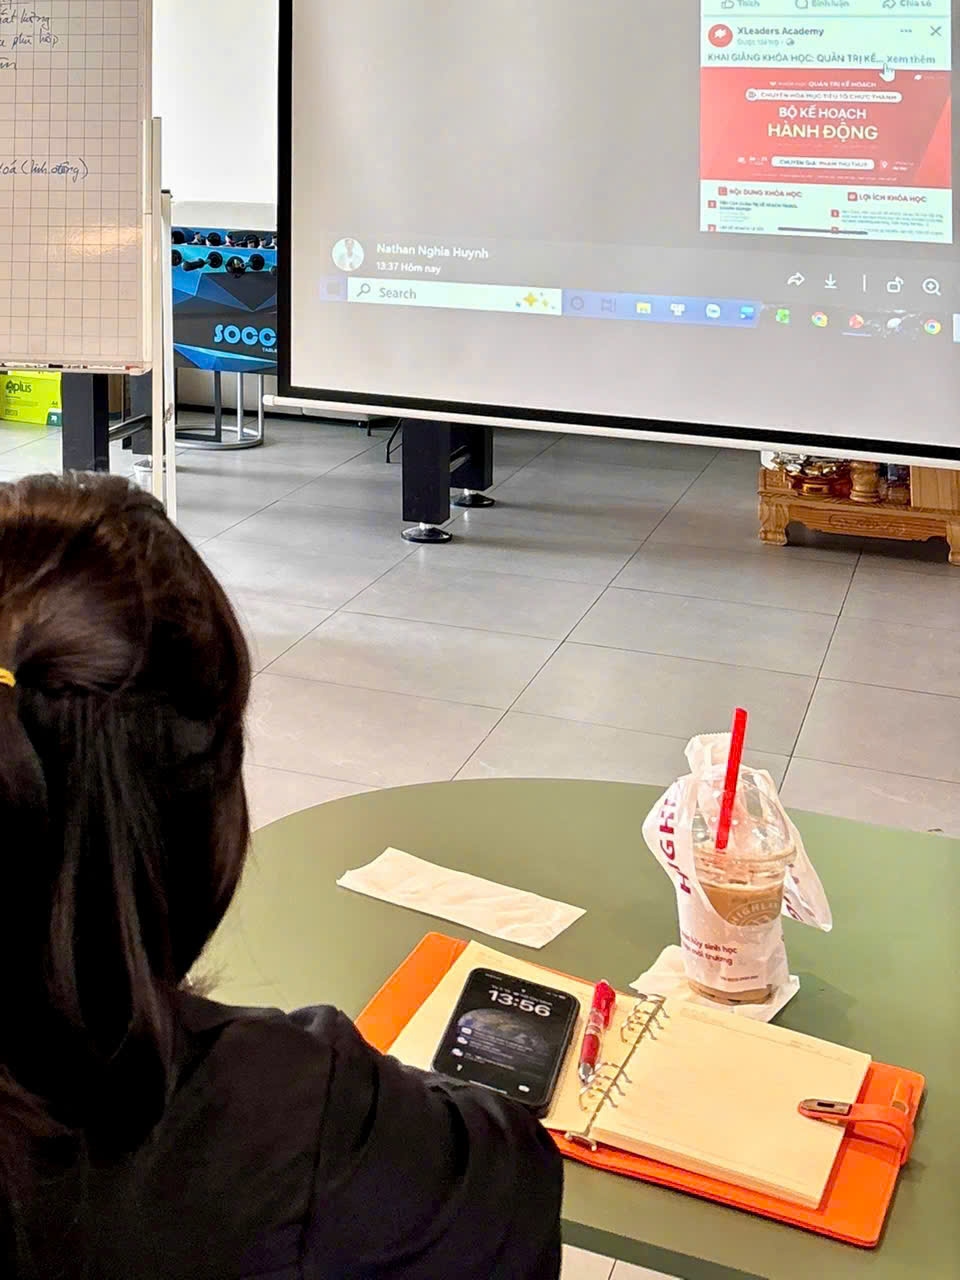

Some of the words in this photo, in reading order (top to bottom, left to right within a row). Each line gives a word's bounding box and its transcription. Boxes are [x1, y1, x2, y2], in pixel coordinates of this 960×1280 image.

[737, 27, 780, 35] XLeaders
[782, 27, 824, 37] Academy
[708, 53, 729, 62] KHAI
[817, 51, 845, 63] QUẢN
[847, 53, 862, 64] TRỊ
[779, 105, 797, 119] BỘ
[800, 105, 816, 119] KẾ
[819, 107, 867, 121] HOẠCH
[767, 120, 819, 138] HÀNH
[823, 119, 878, 142] ĐỘNG
[376, 243, 415, 255] Nathan
[401, 262, 422, 272] Hôm
[424, 265, 441, 275] nay
[379, 287, 417, 299] Search
[488, 989, 552, 1017] 13:56
